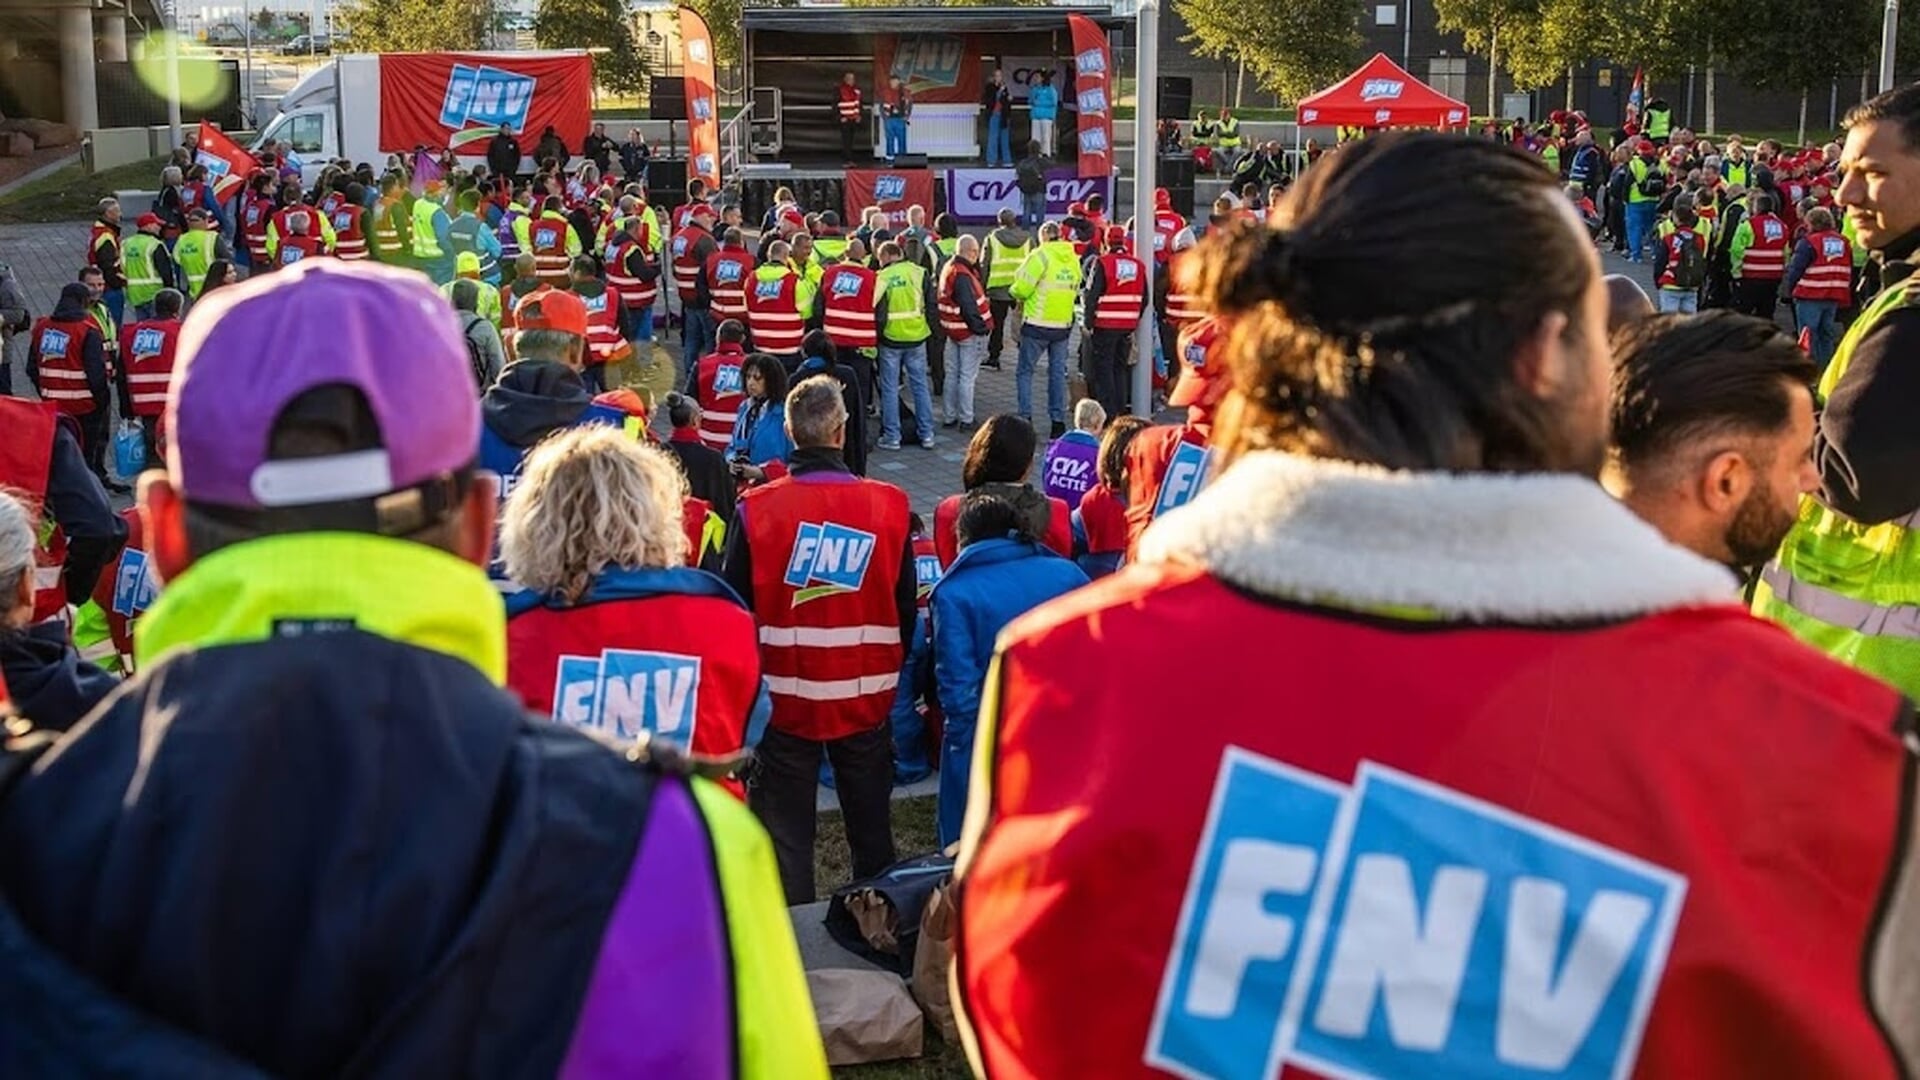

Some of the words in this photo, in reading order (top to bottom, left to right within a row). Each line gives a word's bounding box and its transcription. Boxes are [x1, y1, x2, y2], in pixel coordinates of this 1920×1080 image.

[895, 39, 961, 73] FNV
[447, 78, 532, 116] FNV
[1363, 80, 1402, 97] FNV
[877, 178, 905, 195] FNV
[967, 179, 1018, 201] CNV
[1046, 179, 1096, 201] CNV
[718, 263, 742, 279] FNV
[834, 274, 862, 293] FNV
[42, 334, 69, 354] FNV
[134, 333, 164, 352] FNV
[1052, 457, 1090, 477] CNV
[1051, 475, 1088, 492] ACTIE
[792, 537, 873, 574] FNV
[560, 666, 695, 740] FNV
[1185, 837, 1653, 1072] FNV
